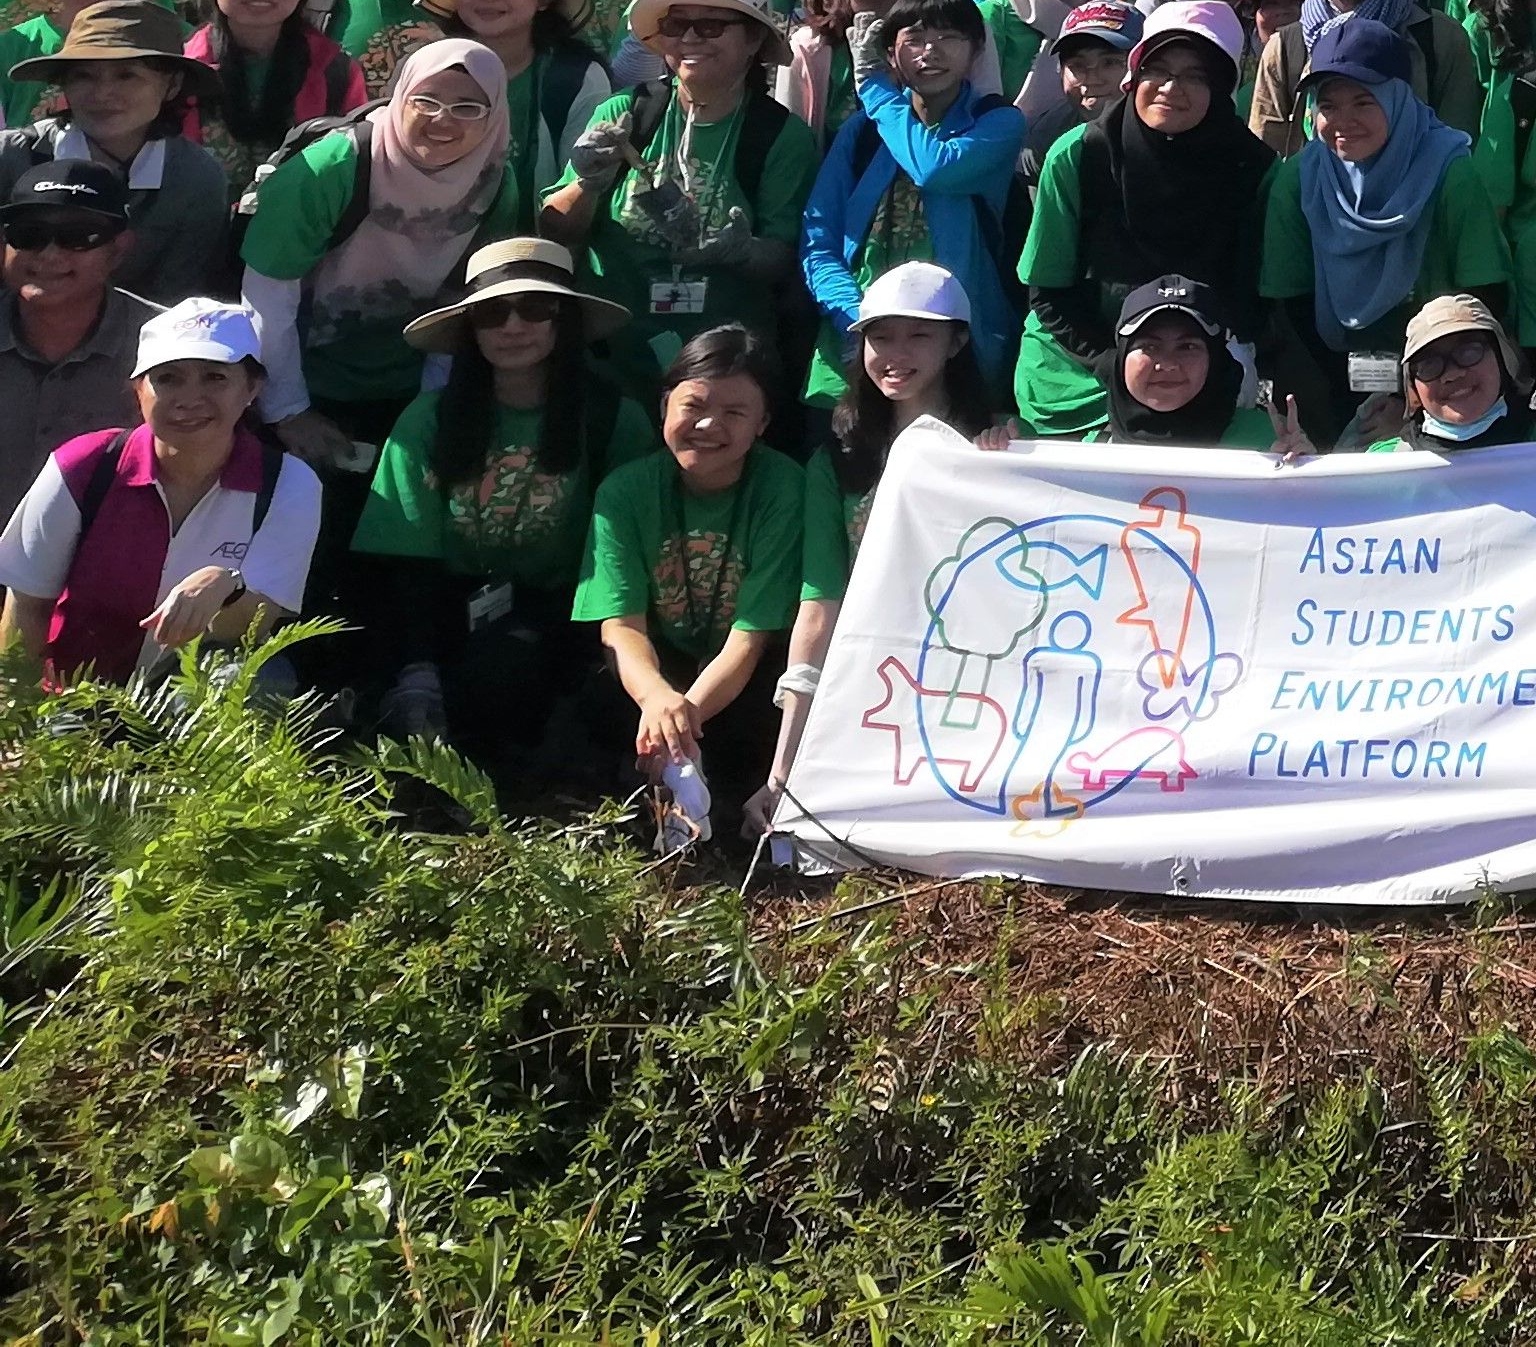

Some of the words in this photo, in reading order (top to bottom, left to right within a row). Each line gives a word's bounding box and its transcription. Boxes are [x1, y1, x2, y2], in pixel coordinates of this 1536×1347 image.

[209, 541, 249, 561] AEO
[1299, 526, 1441, 575] ASIAN
[1292, 598, 1515, 647] STUDENTS
[1248, 732, 1487, 778] PLATFORM
